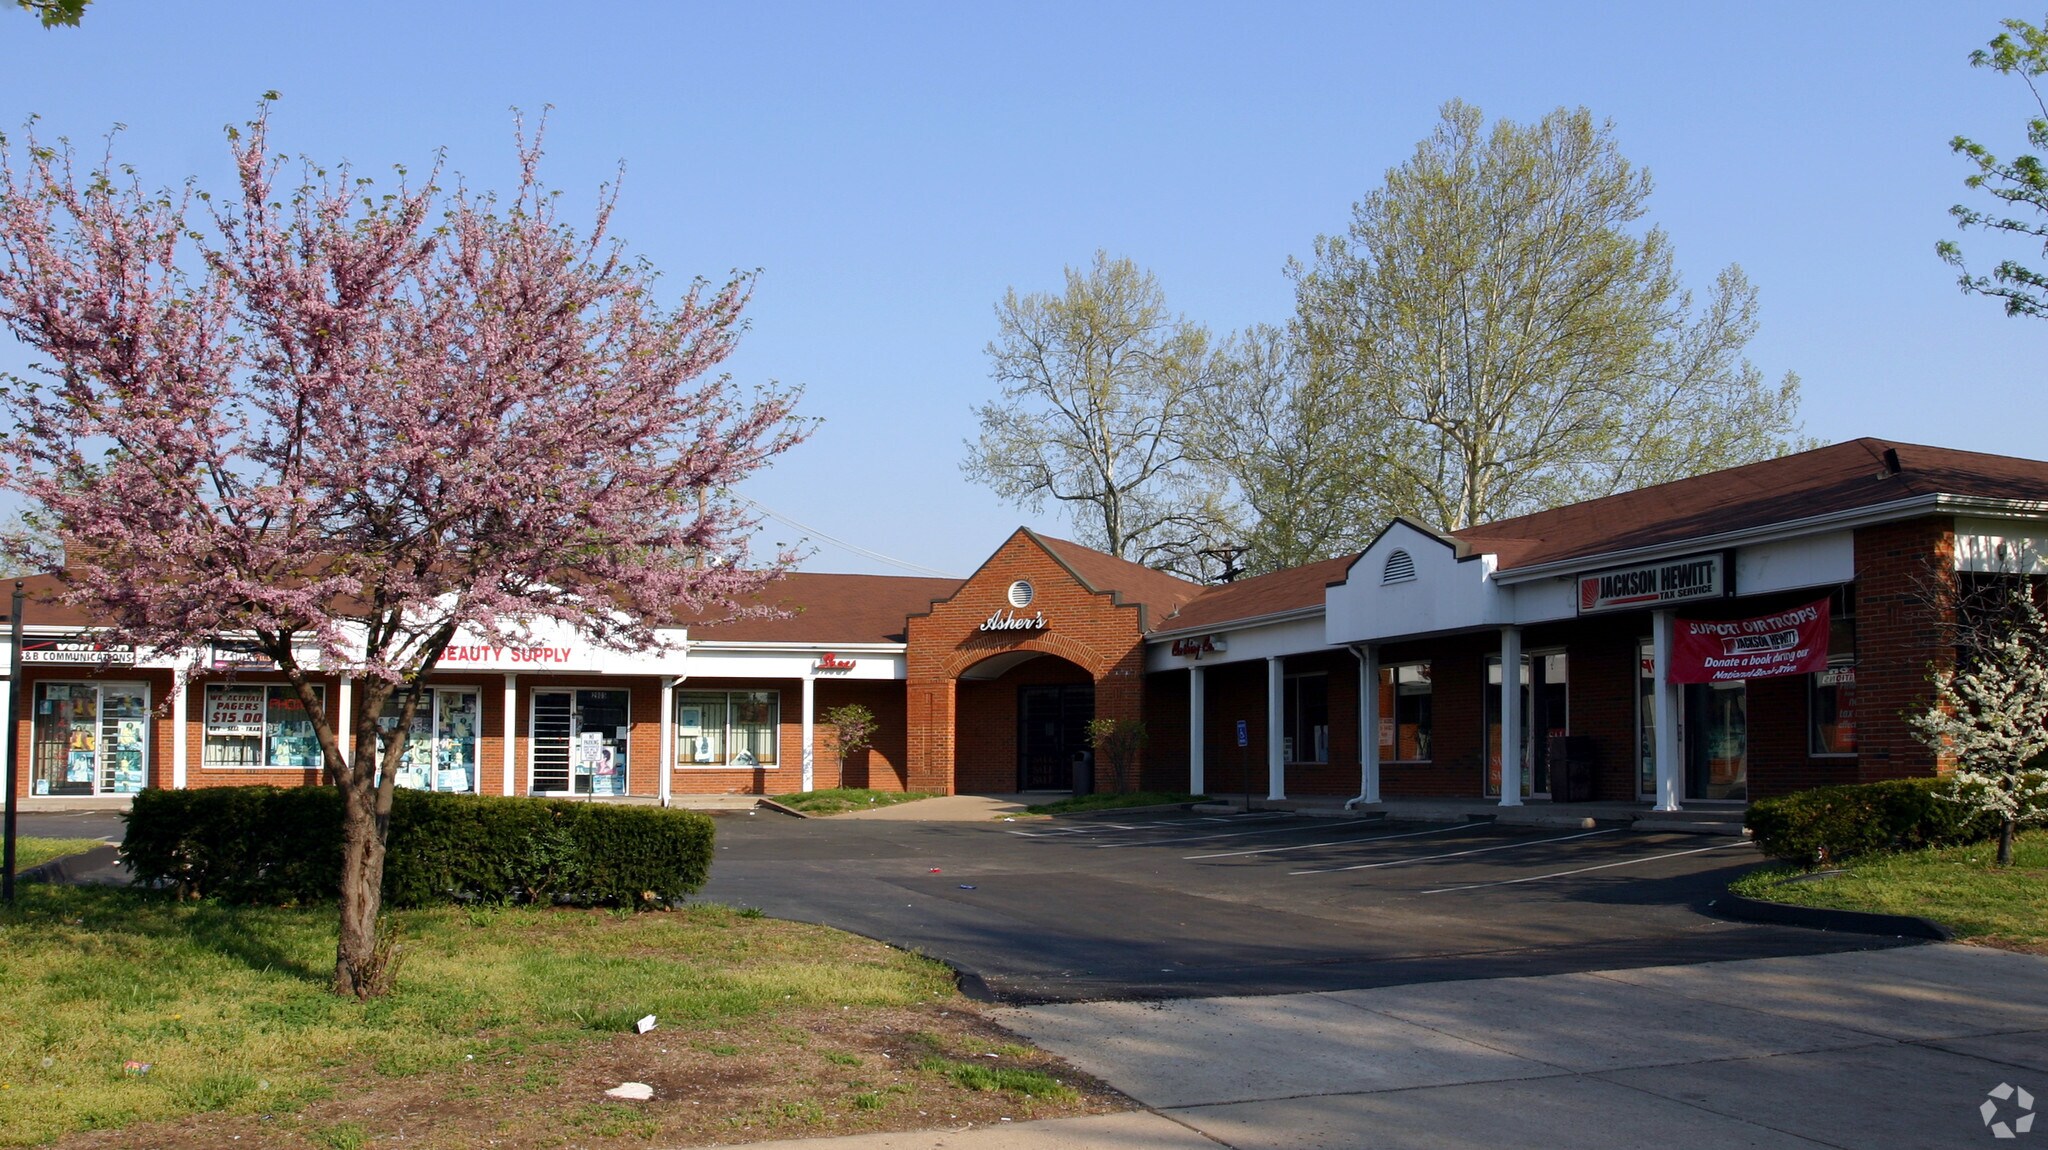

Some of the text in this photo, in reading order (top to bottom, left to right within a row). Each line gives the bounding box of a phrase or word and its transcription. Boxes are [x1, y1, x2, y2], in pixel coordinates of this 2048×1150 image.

[1600, 560, 1713, 599] JACKSON HEWITT
[1660, 584, 1712, 600] TAX SERVICE
[980, 608, 1048, 631] Asher's
[1690, 606, 1818, 635] SUPPORT OUR TROOPS!
[1736, 630, 1796, 649] JACKSON HEWITT
[511, 647, 572, 662] SUPPLY
[1704, 656, 1740, 668] Donate
[1741, 658, 1748, 667] a
[1749, 654, 1772, 666] book
[210, 694, 224, 702] WE
[216, 702, 259, 711] PAGERS
[211, 711, 263, 723] $15.00
